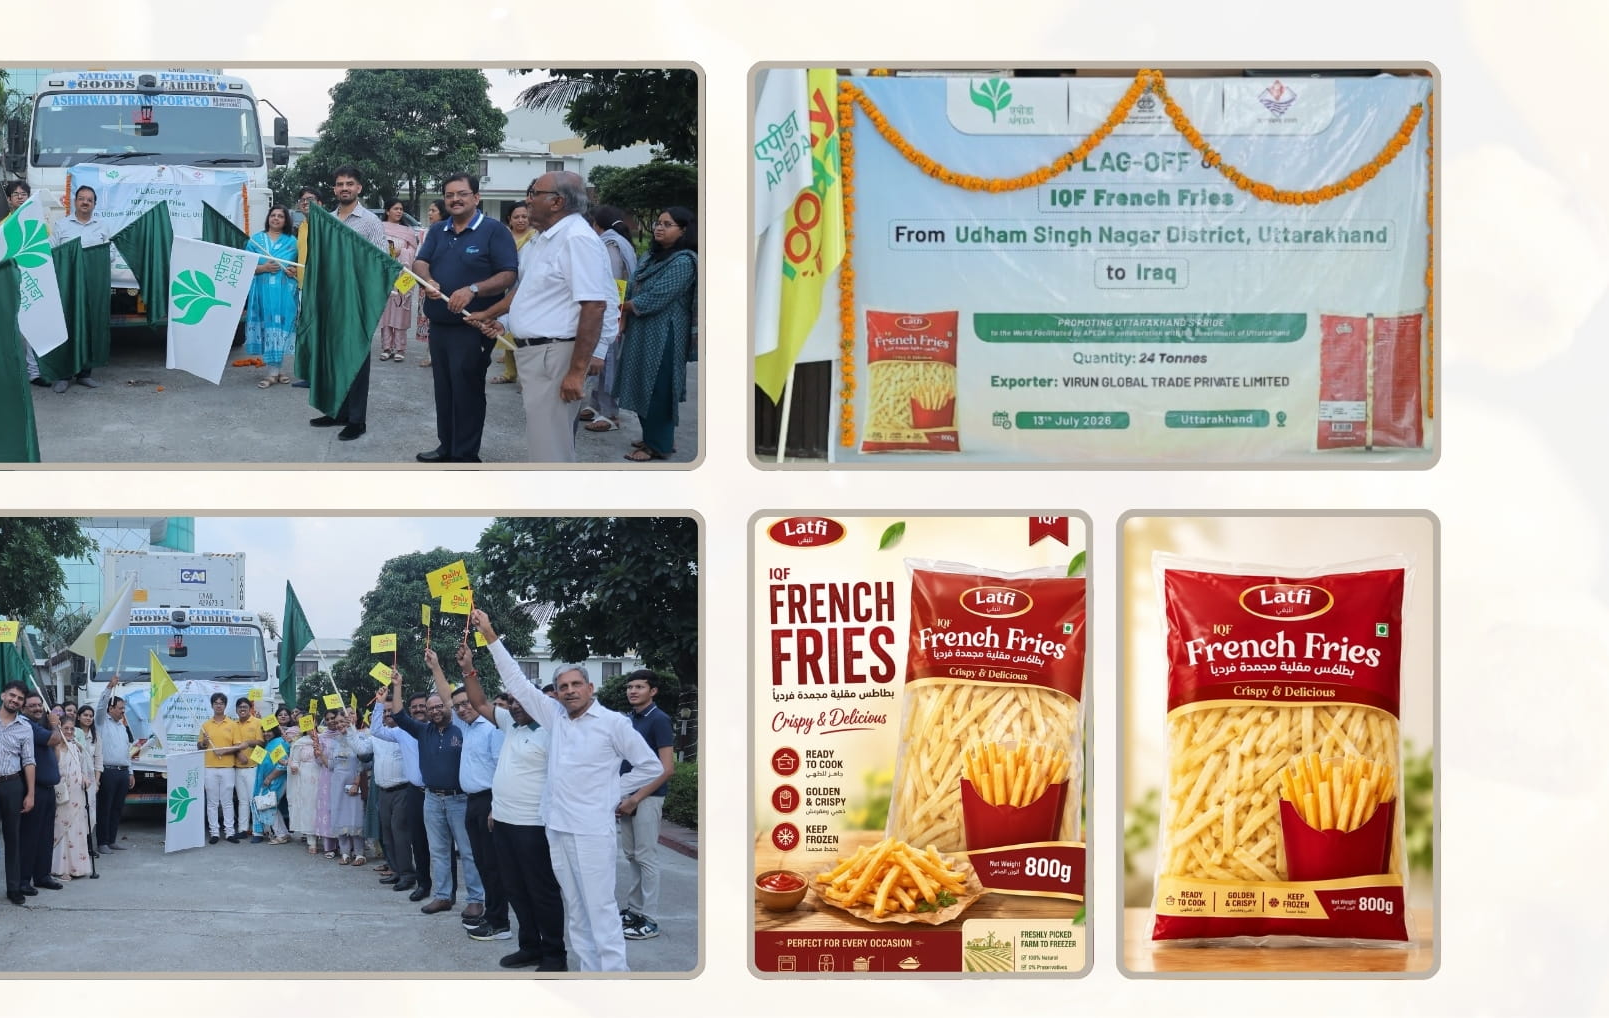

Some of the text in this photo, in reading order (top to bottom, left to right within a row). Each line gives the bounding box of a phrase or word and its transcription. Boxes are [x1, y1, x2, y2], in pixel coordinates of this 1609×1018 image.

[77, 73, 215, 82] NATIONAL PERMIT
[77, 80, 217, 91] GOODS CARRIER
[52, 95, 120, 106] ASHIRWAD
[755, 110, 800, 163] एपीडा
[765, 134, 812, 192] APEDA
[1050, 188, 1235, 207] IQF French Fries
[895, 225, 1388, 247] From Udham Singh Nagar District, Uttarakhand
[228, 254, 246, 289] APEDA
[1106, 263, 1177, 284] to Iraq
[1058, 319, 1113, 327] PROMOTING
[875, 334, 917, 348] French
[920, 335, 950, 349] Fries
[1073, 352, 1208, 366] Quantity: 24 Tonnes
[991, 375, 1290, 390] Exporter: VIRUN GLOBAL TRADE PRIVATE LIMITED
[1055, 416, 1079, 428] July
[1083, 416, 1112, 426] 2026
[1181, 414, 1253, 424] Uttarakhand
[784, 521, 828, 537] Latfi
[769, 567, 791, 581] IQF
[770, 581, 895, 624] FRENCH
[975, 591, 1016, 606] Latfi
[1260, 588, 1312, 606] Latfi
[189, 615, 232, 623] CARRIER
[937, 619, 953, 629] IQF
[1213, 624, 1233, 637] IQF
[918, 626, 1067, 660] French Fries
[1185, 630, 1382, 668] French Fries
[771, 625, 896, 686] FRIES
[955, 650, 984, 659] مجمدة
[986, 650, 1011, 661] مقلية
[1240, 661, 1277, 674] مجمدة
[1280, 660, 1312, 675] مقلية
[949, 667, 1028, 681] Crispy & Delicious
[797, 691, 828, 701] مجمدة
[831, 689, 856, 701] مقلية
[859, 689, 895, 700] بطاطس
[1233, 685, 1336, 698] Crispy & Delicious
[772, 707, 887, 735] Crispy & Delicious
[806, 750, 834, 758] READY
[806, 760, 843, 768] TO COOK
[806, 787, 840, 796] GOLDEN
[806, 797, 846, 806] & CRISPY
[806, 825, 828, 833] KEEP
[806, 835, 839, 844] FROZEN
[1001, 860, 1021, 868] Weight
[1025, 856, 1072, 883] 800g
[1181, 891, 1203, 899] READY
[1287, 893, 1305, 901] KEEP
[1188, 899, 1206, 907] COOK
[1231, 899, 1257, 907] CRISPY
[1283, 900, 1310, 909] FROZEN
[1358, 896, 1394, 915] 800g
[787, 939, 912, 948] PERFECT FOR EVERY OCCASION
